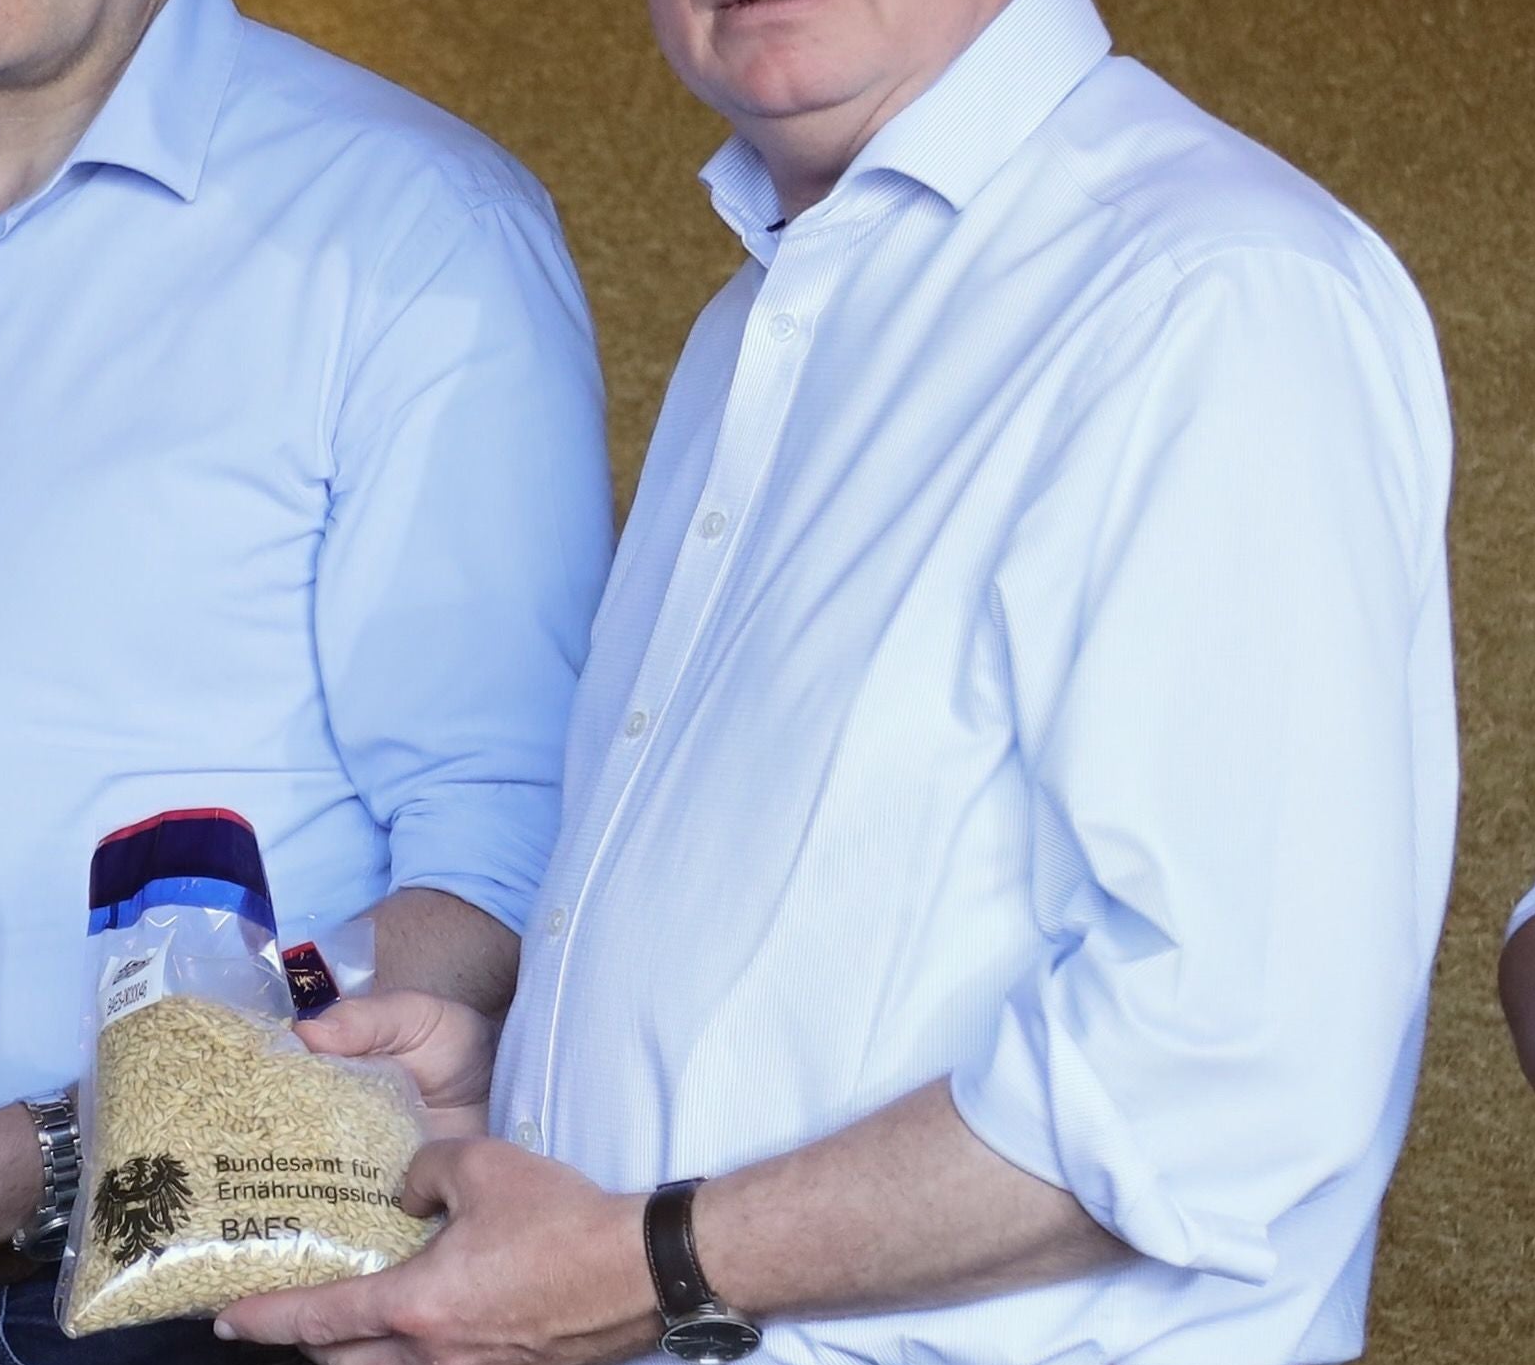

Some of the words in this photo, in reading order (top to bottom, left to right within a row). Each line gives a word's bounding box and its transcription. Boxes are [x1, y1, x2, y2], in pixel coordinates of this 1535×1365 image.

[216, 1154, 343, 1174] Bundesamt
[352, 1158, 381, 1180] für
[218, 1180, 403, 1209] Ernährungssiche
[221, 1216, 303, 1242] BAES
